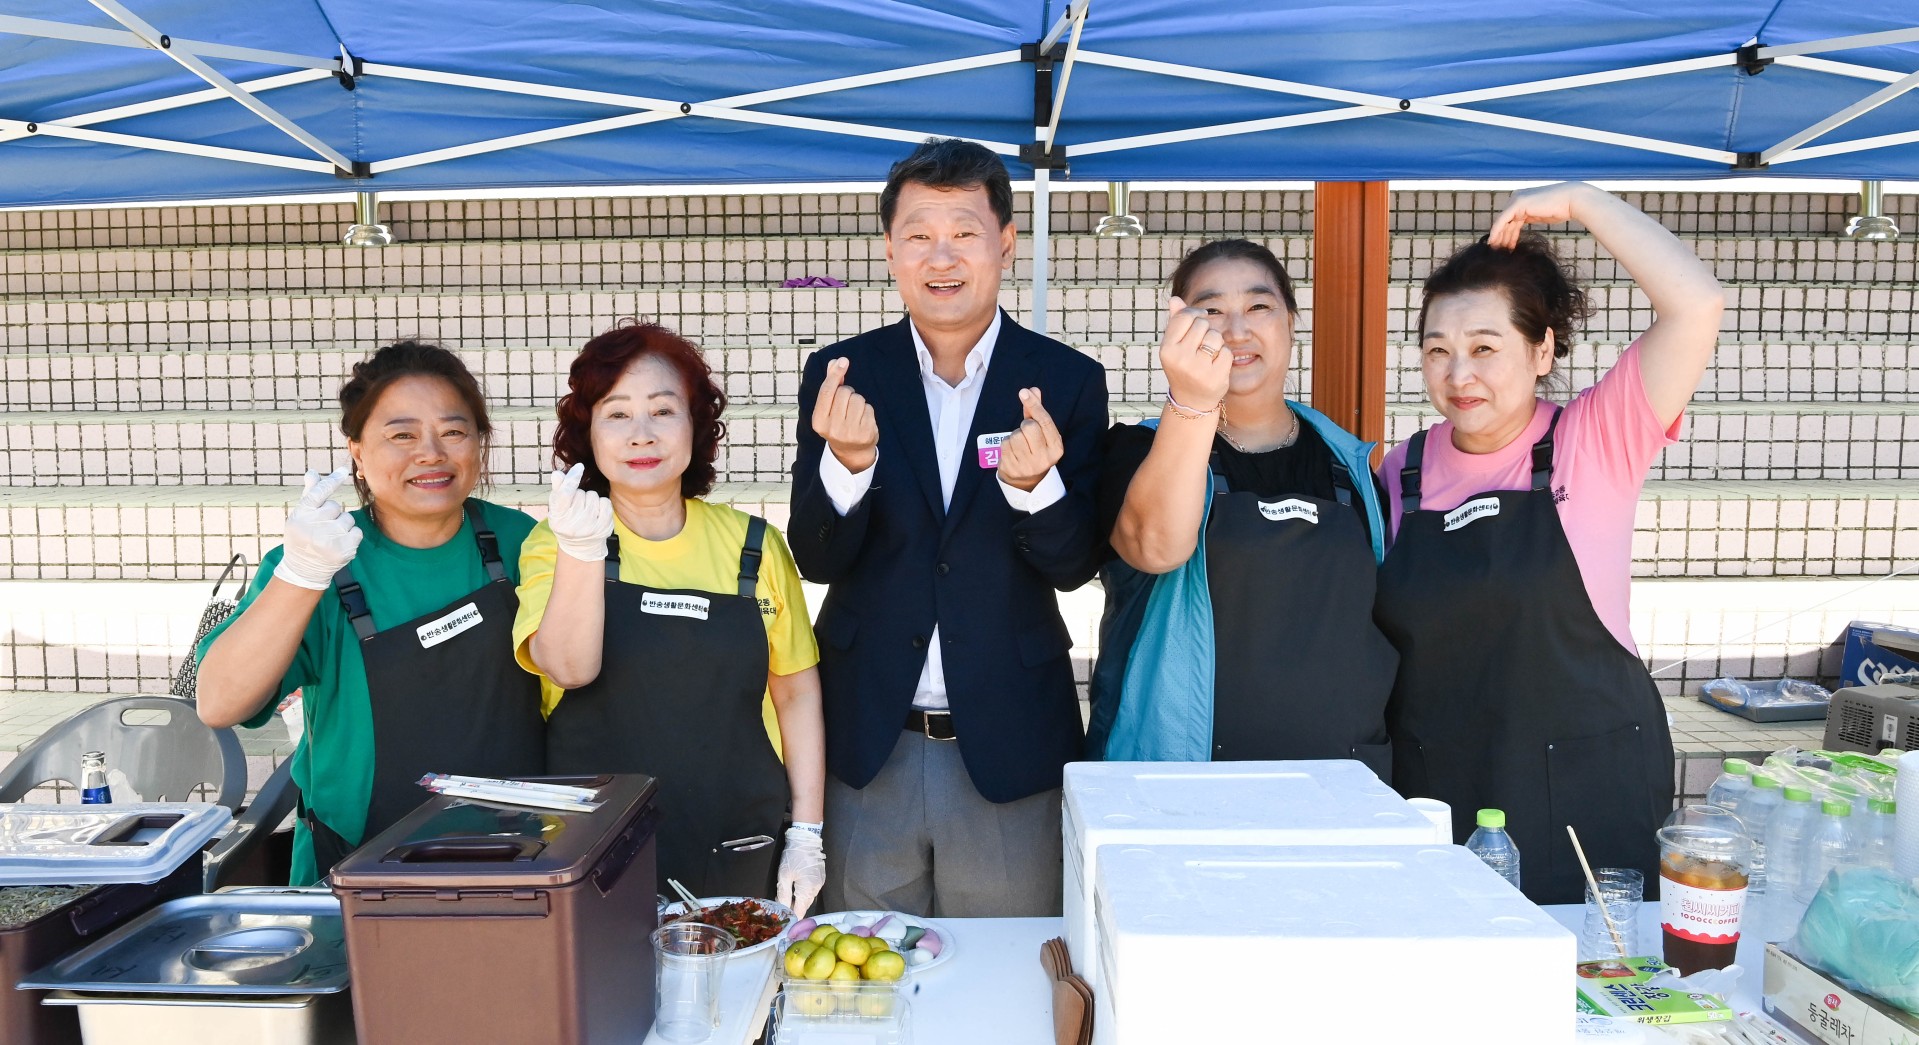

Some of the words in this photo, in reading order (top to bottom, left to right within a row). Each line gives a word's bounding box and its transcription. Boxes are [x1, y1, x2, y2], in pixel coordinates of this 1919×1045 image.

[984, 449, 1000, 466] 김
[1450, 503, 1494, 526] 반송생활문화센터
[648, 600, 704, 613] 반송생활문화센터
[425, 611, 475, 639] 반송생활문화센터
[1636, 1015, 1672, 1025] 위생장갑
[1807, 1002, 1856, 1045] 둥굴레차
